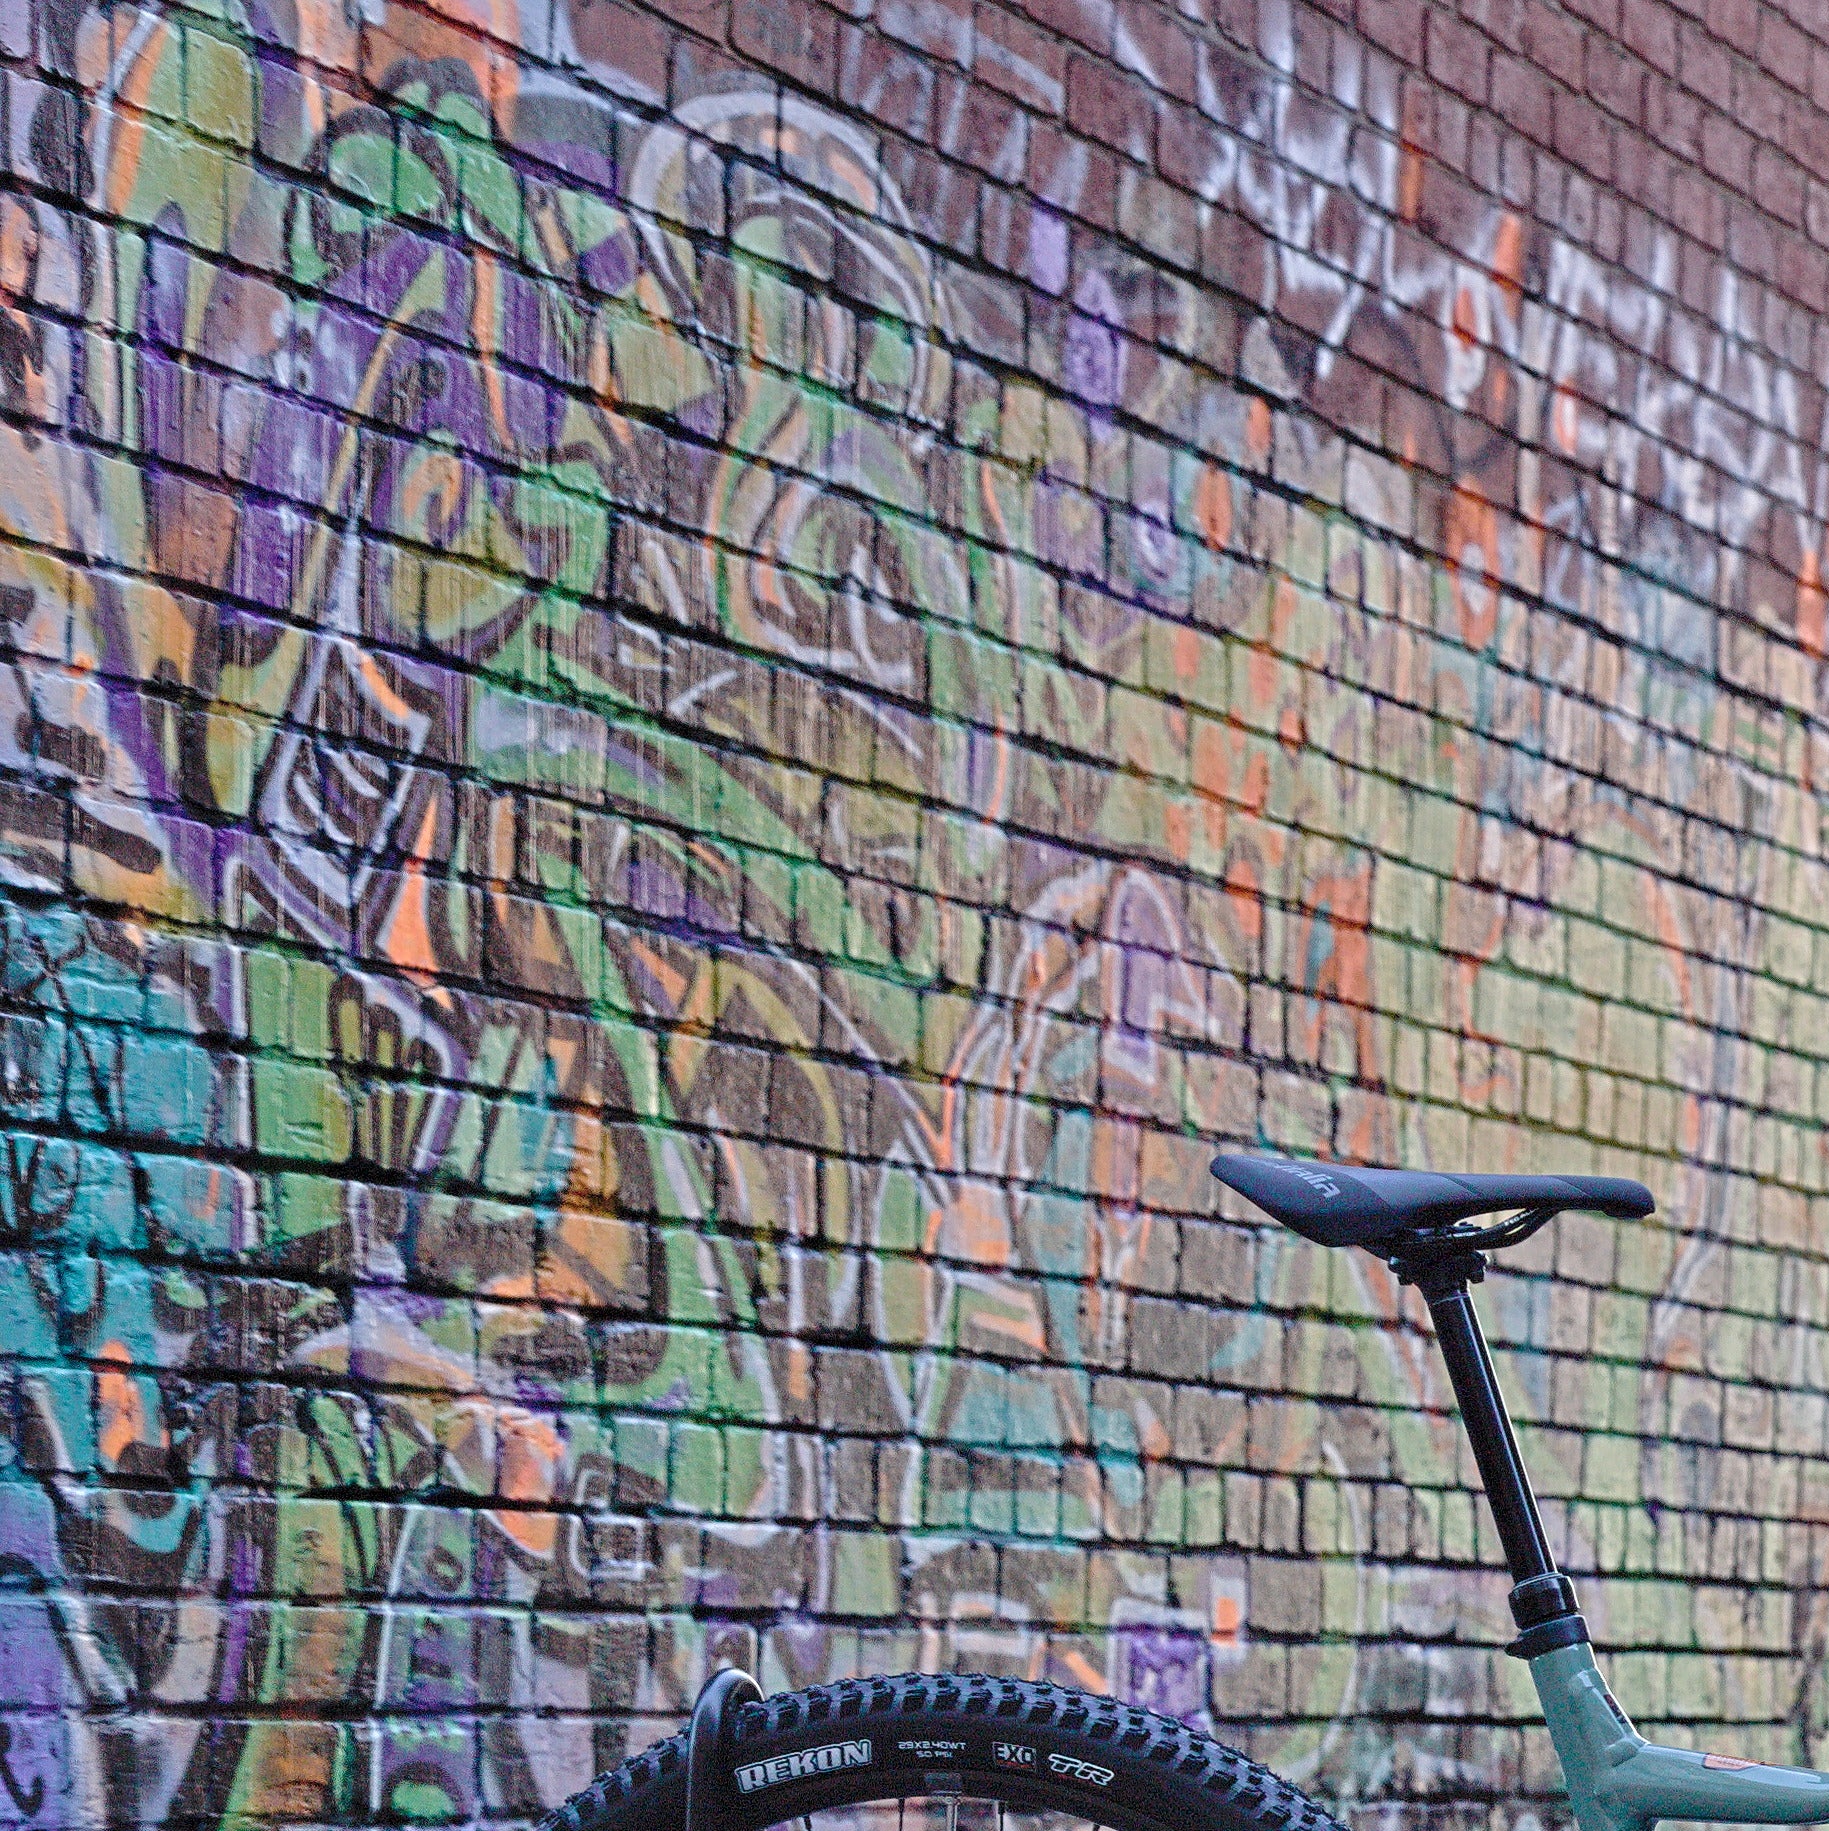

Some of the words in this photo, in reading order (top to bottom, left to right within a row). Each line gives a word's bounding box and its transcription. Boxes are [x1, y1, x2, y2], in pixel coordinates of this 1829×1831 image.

[734, 1738, 872, 1794] REKON
[993, 1743, 1036, 1766] EXO
[1049, 1753, 1115, 1786] TR
